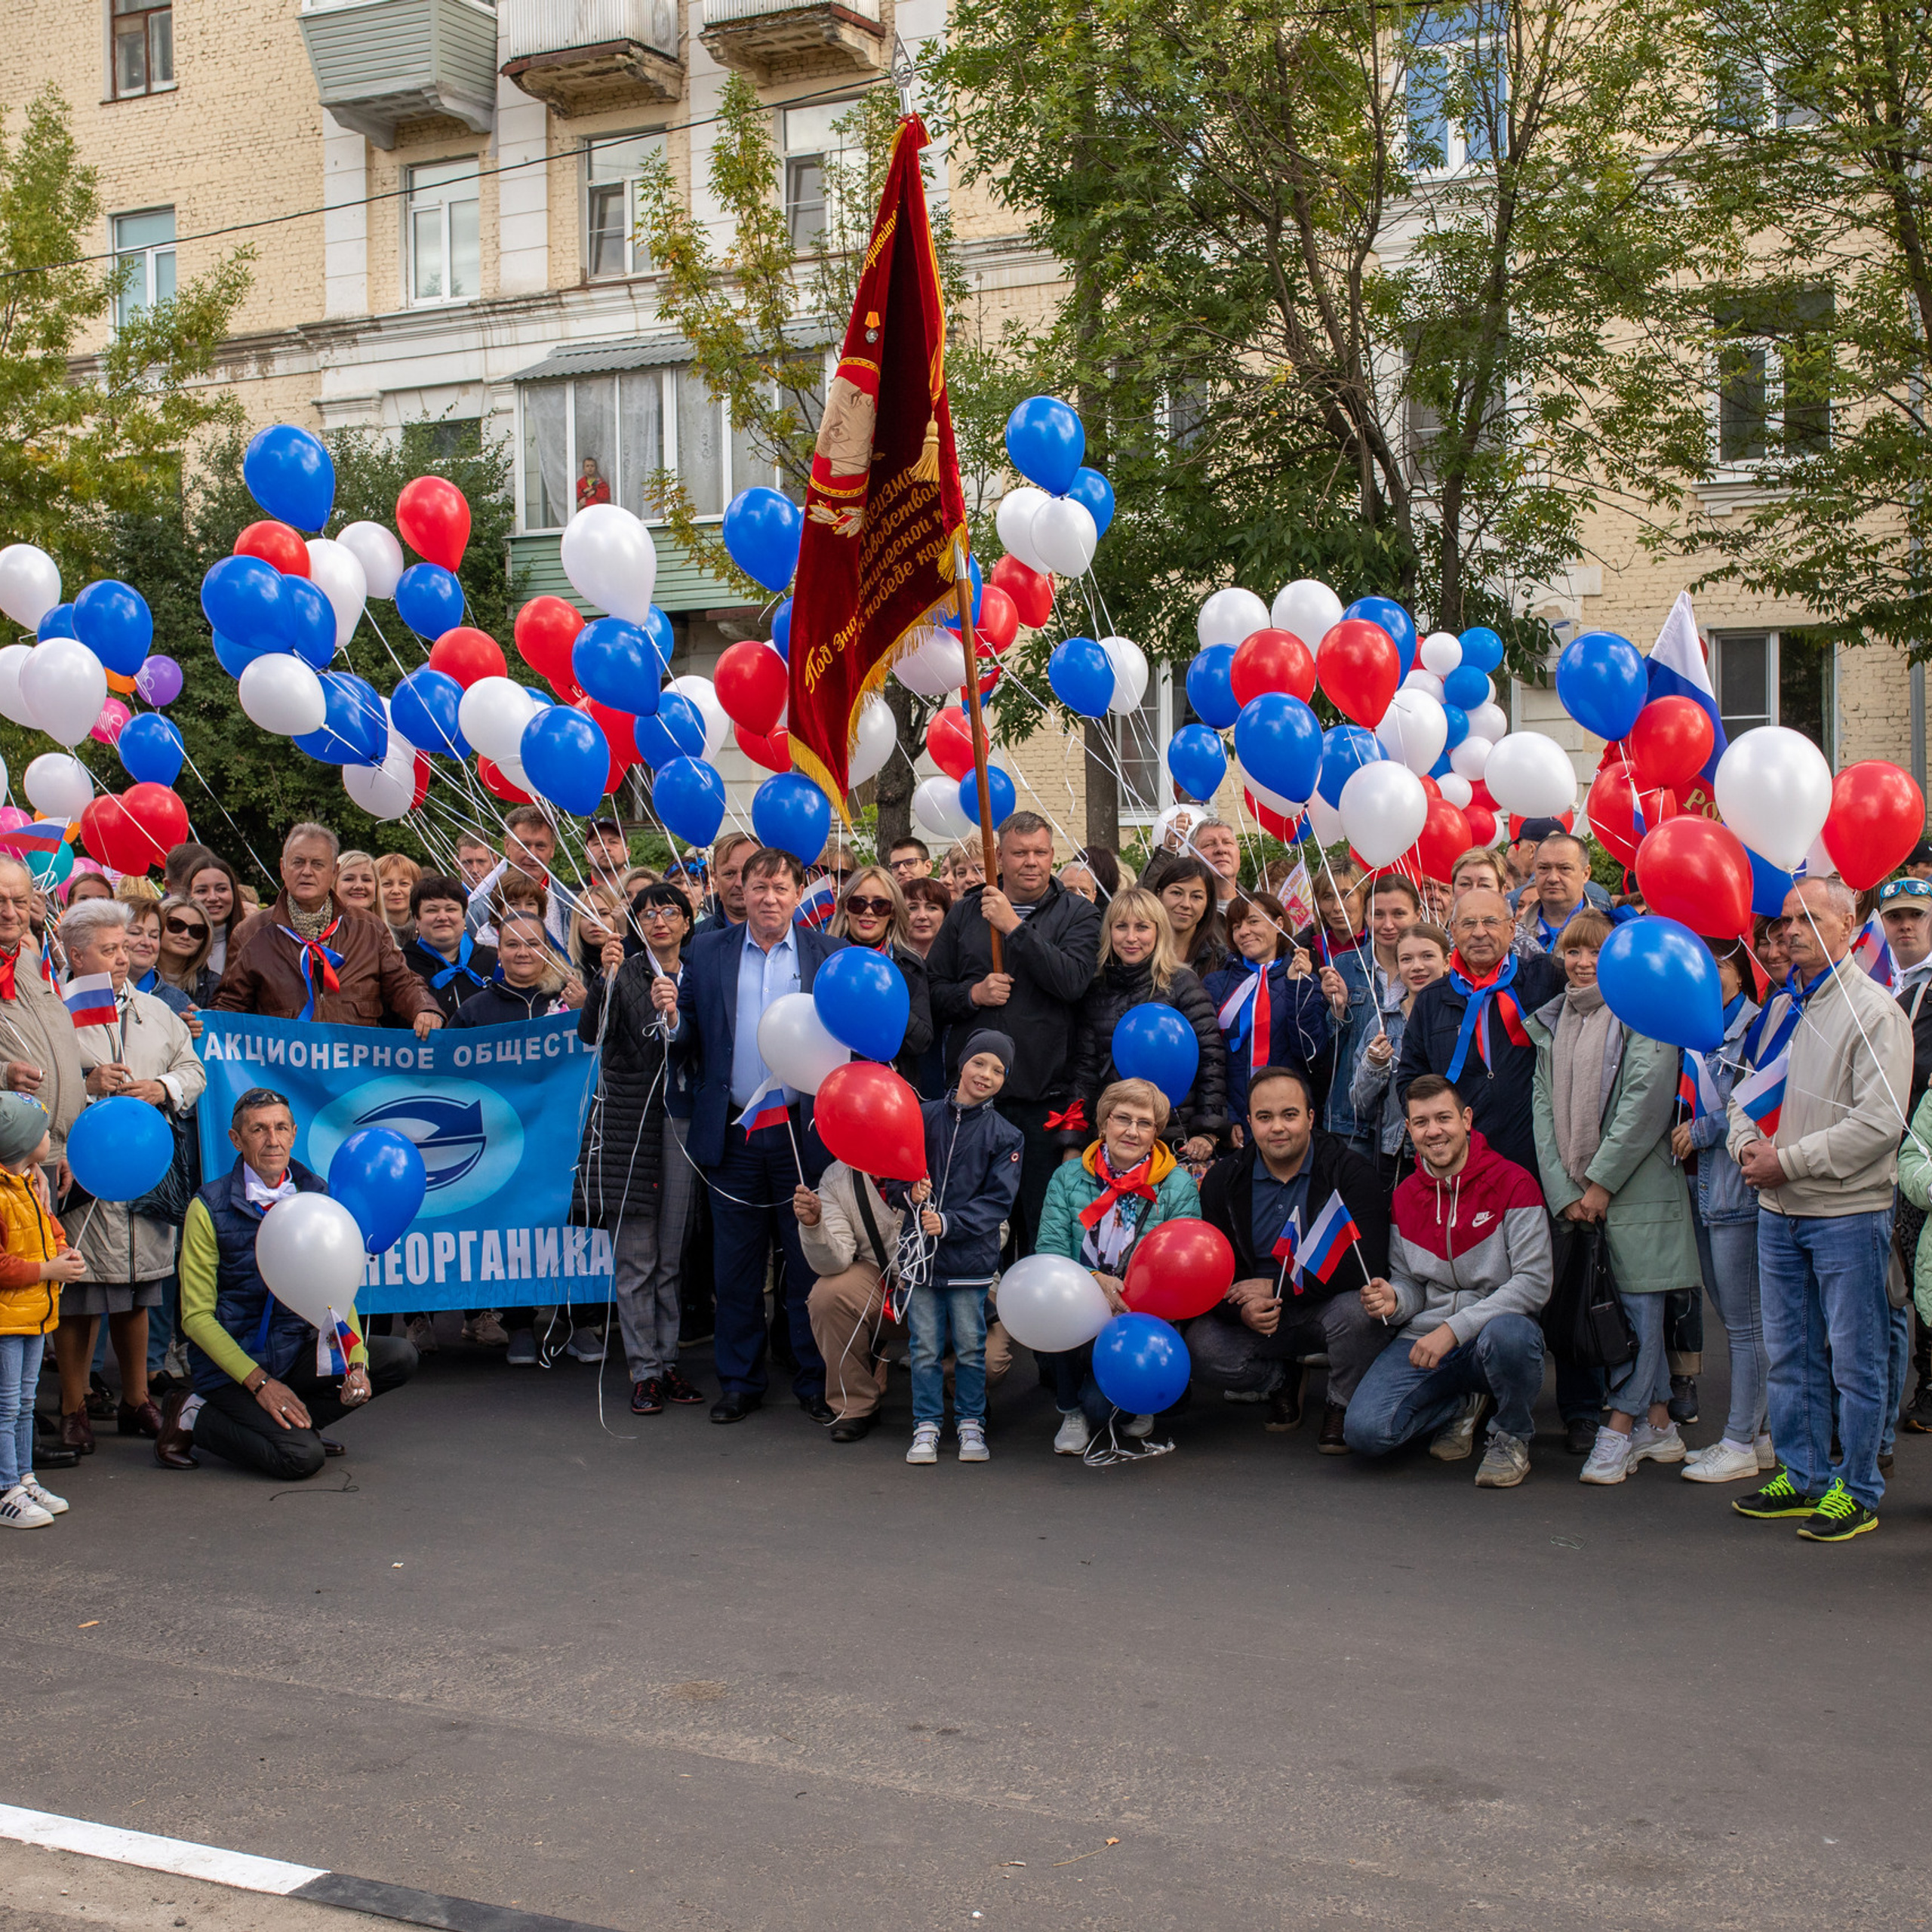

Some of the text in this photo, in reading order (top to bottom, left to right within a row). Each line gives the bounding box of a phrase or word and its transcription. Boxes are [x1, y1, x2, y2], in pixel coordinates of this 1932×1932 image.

[864, 561, 915, 619] победе
[804, 643, 832, 694] Под
[204, 1032, 434, 1070] АКЦИОНЕРНОЕ
[360, 1226, 615, 1287] НЕОРГАНИКА
